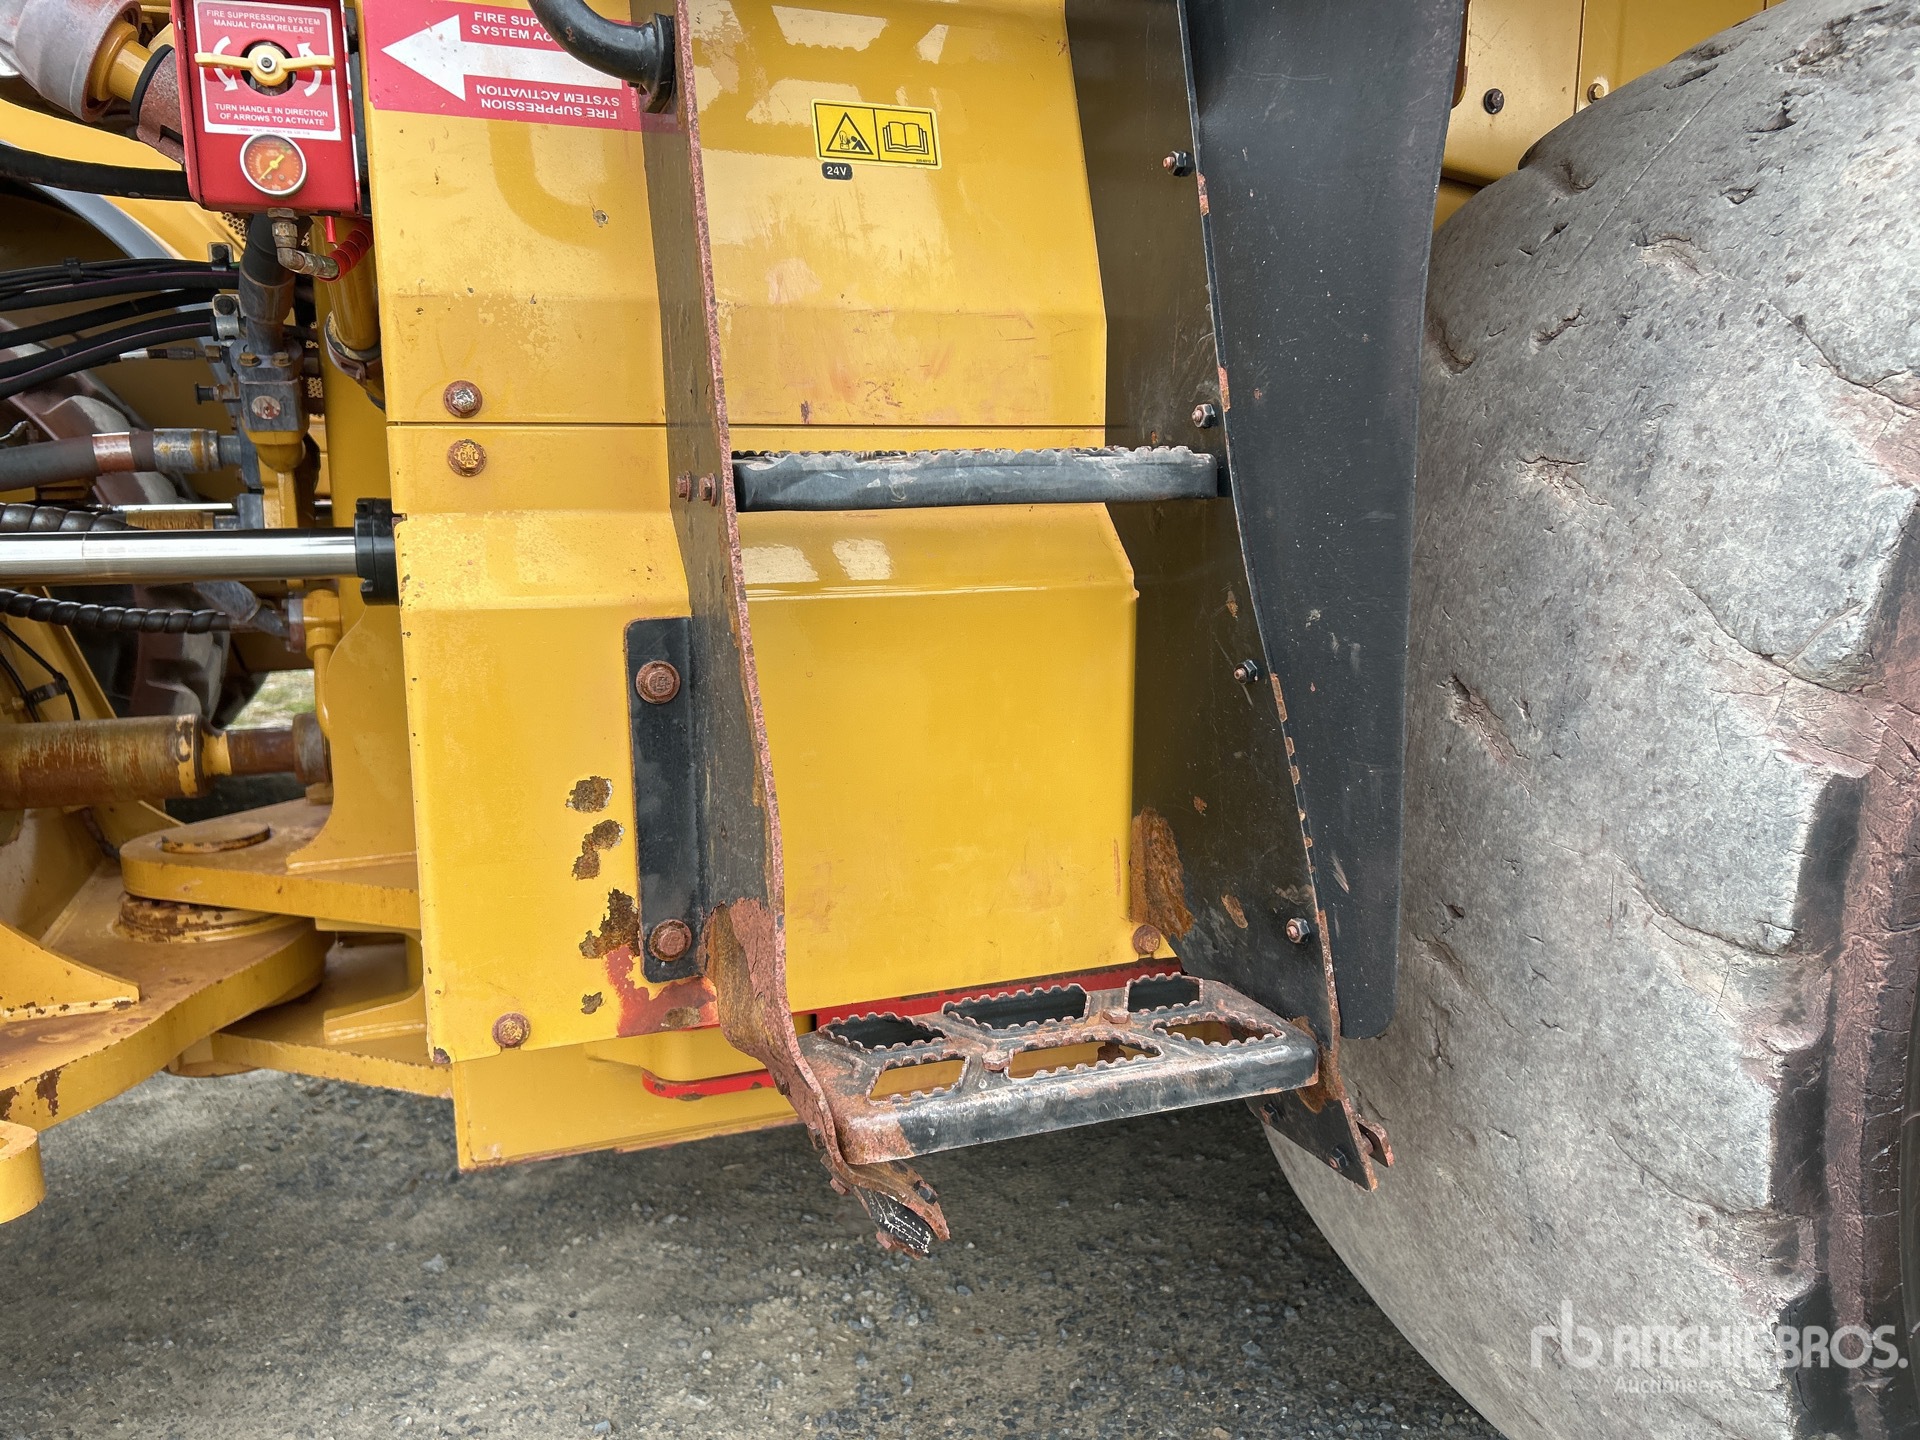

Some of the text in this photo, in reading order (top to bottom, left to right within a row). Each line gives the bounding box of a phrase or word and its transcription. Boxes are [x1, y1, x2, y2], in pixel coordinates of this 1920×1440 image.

[206, 9, 321, 26] FIRE SUPPRESSION SYSTEM
[474, 11, 543, 28] FIRE SUP
[213, 19, 315, 34] MANUAL FOAM RELEASE
[471, 24, 530, 40] SYSTEM
[476, 84, 620, 107] SYSTEM ACTIVATION
[214, 102, 329, 118] TURN HANDLE IN DIRECTION
[481, 98, 618, 120] FIRE SUPPRESSION
[219, 112, 325, 126] OF ARROWS TO ACTIVATE
[826, 165, 847, 176] 24V
